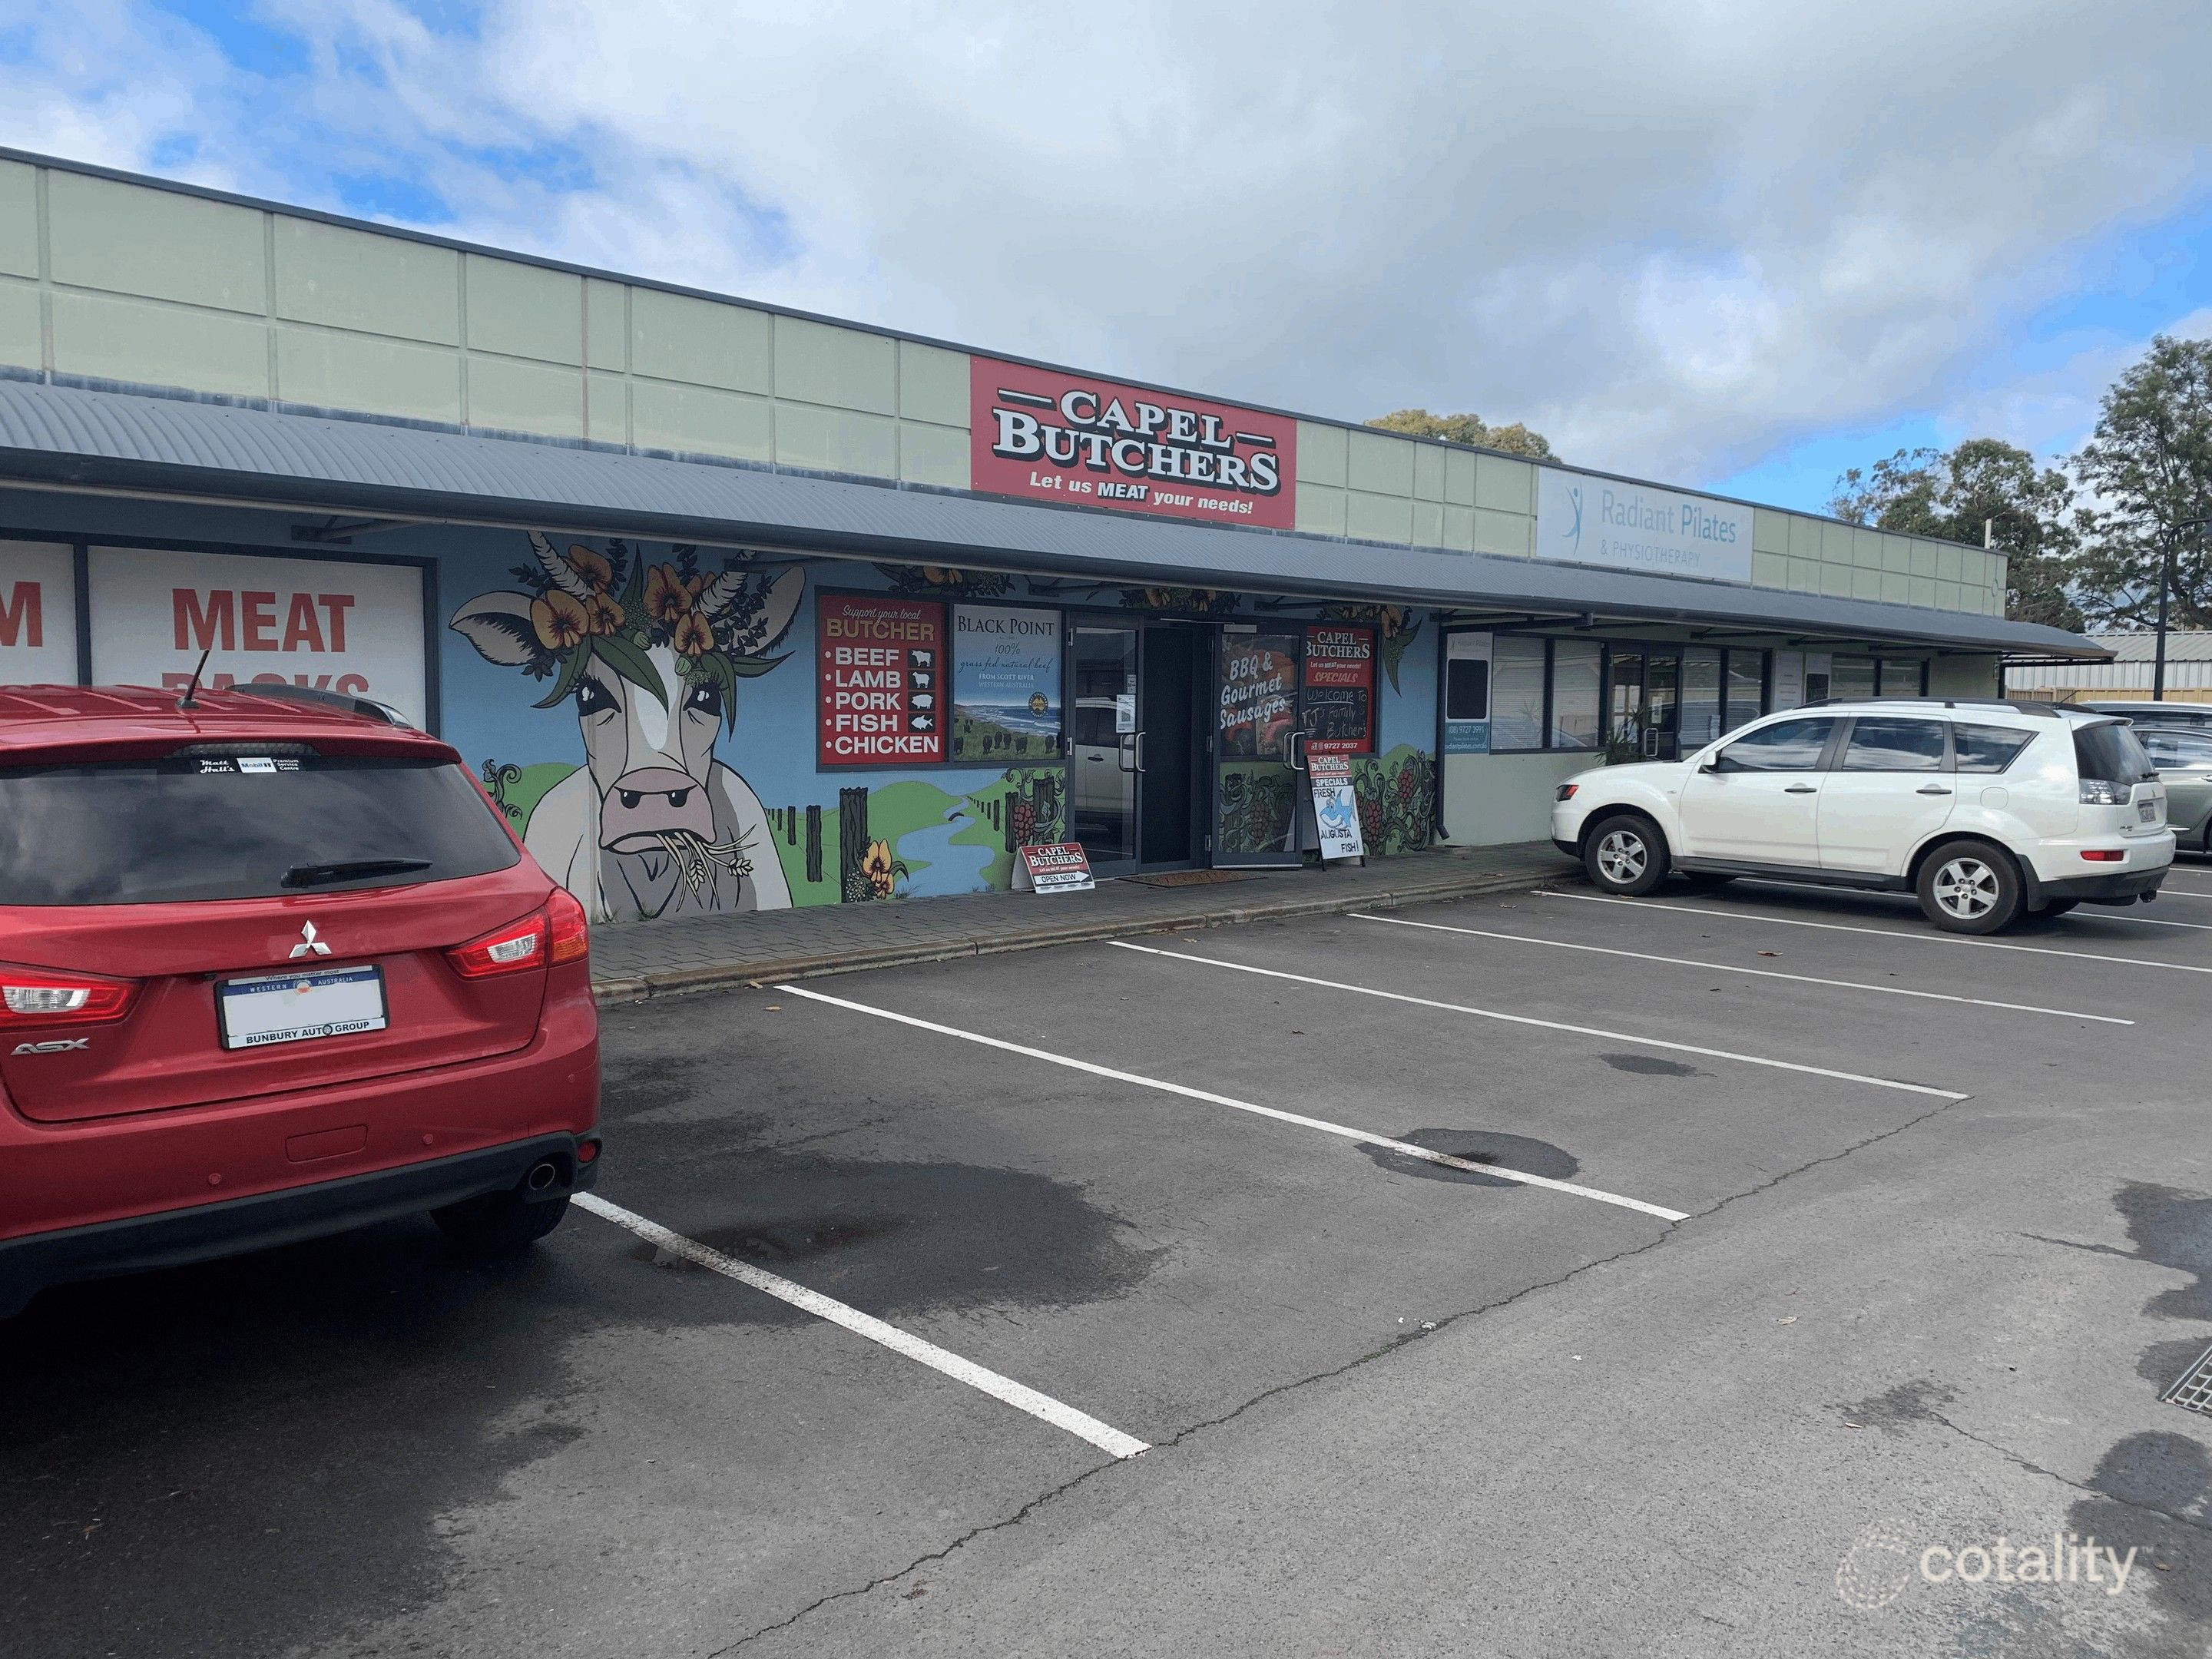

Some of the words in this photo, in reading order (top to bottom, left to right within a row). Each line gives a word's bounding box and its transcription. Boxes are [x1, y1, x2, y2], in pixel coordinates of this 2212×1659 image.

[1060, 390, 1233, 450] CAPEL
[992, 408, 1280, 493] BUTCHERS
[1030, 472, 1062, 489] Let
[1068, 481, 1092, 493] us
[1097, 482, 1150, 500] MEAT
[1154, 492, 1193, 507] your
[1198, 497, 1253, 514] needs!
[1602, 489, 1674, 534] Radiant
[1681, 504, 1737, 544] Pilates
[1600, 538, 1608, 555] &
[1613, 541, 1700, 568] PHYSIOTHERAPY
[172, 588, 355, 652] MEAT
[843, 604, 877, 619] Support
[877, 611, 898, 623] your
[900, 609, 921, 620] local
[826, 618, 935, 641] BUTCHER
[958, 615, 1005, 634] BLACK
[1010, 618, 1055, 636] POINT
[1317, 631, 1356, 645] CAPEL
[836, 647, 899, 666] BEEF
[995, 642, 1021, 655] 100%
[1306, 641, 1370, 659] BUTCHERS
[959, 661, 982, 673] grass
[983, 657, 999, 671] fed
[1001, 658, 1034, 670] natural
[1034, 658, 1053, 673] beef
[1230, 654, 1259, 681] BBQ
[1263, 651, 1273, 671] &
[836, 670, 901, 688] LAMB
[1313, 671, 1359, 683] SPECIALS
[1221, 672, 1282, 706] Gourmet
[1307, 688, 1353, 702] Welcome
[836, 692, 901, 710] PORK
[836, 714, 898, 732] FISH
[1220, 698, 1286, 730] Sausages
[1459, 725, 1471, 733] 9727
[835, 736, 939, 754] CHICKEN
[1311, 761, 1349, 772] BUTCHERS
[1316, 777, 1348, 786] SPECIALS
[1313, 787, 1336, 798] FRESH
[1321, 830, 1352, 839] AUGUSTA
[1038, 846, 1070, 856] CAPEL
[1341, 840, 1359, 853] FISH!
[1028, 853, 1083, 866] BUTCHERS
[317, 977, 353, 985] AUSTRALIA
[246, 1030, 298, 1044] BUNBURY
[335, 1022, 369, 1032] GROUP
[10, 1038, 90, 1056] ASX
